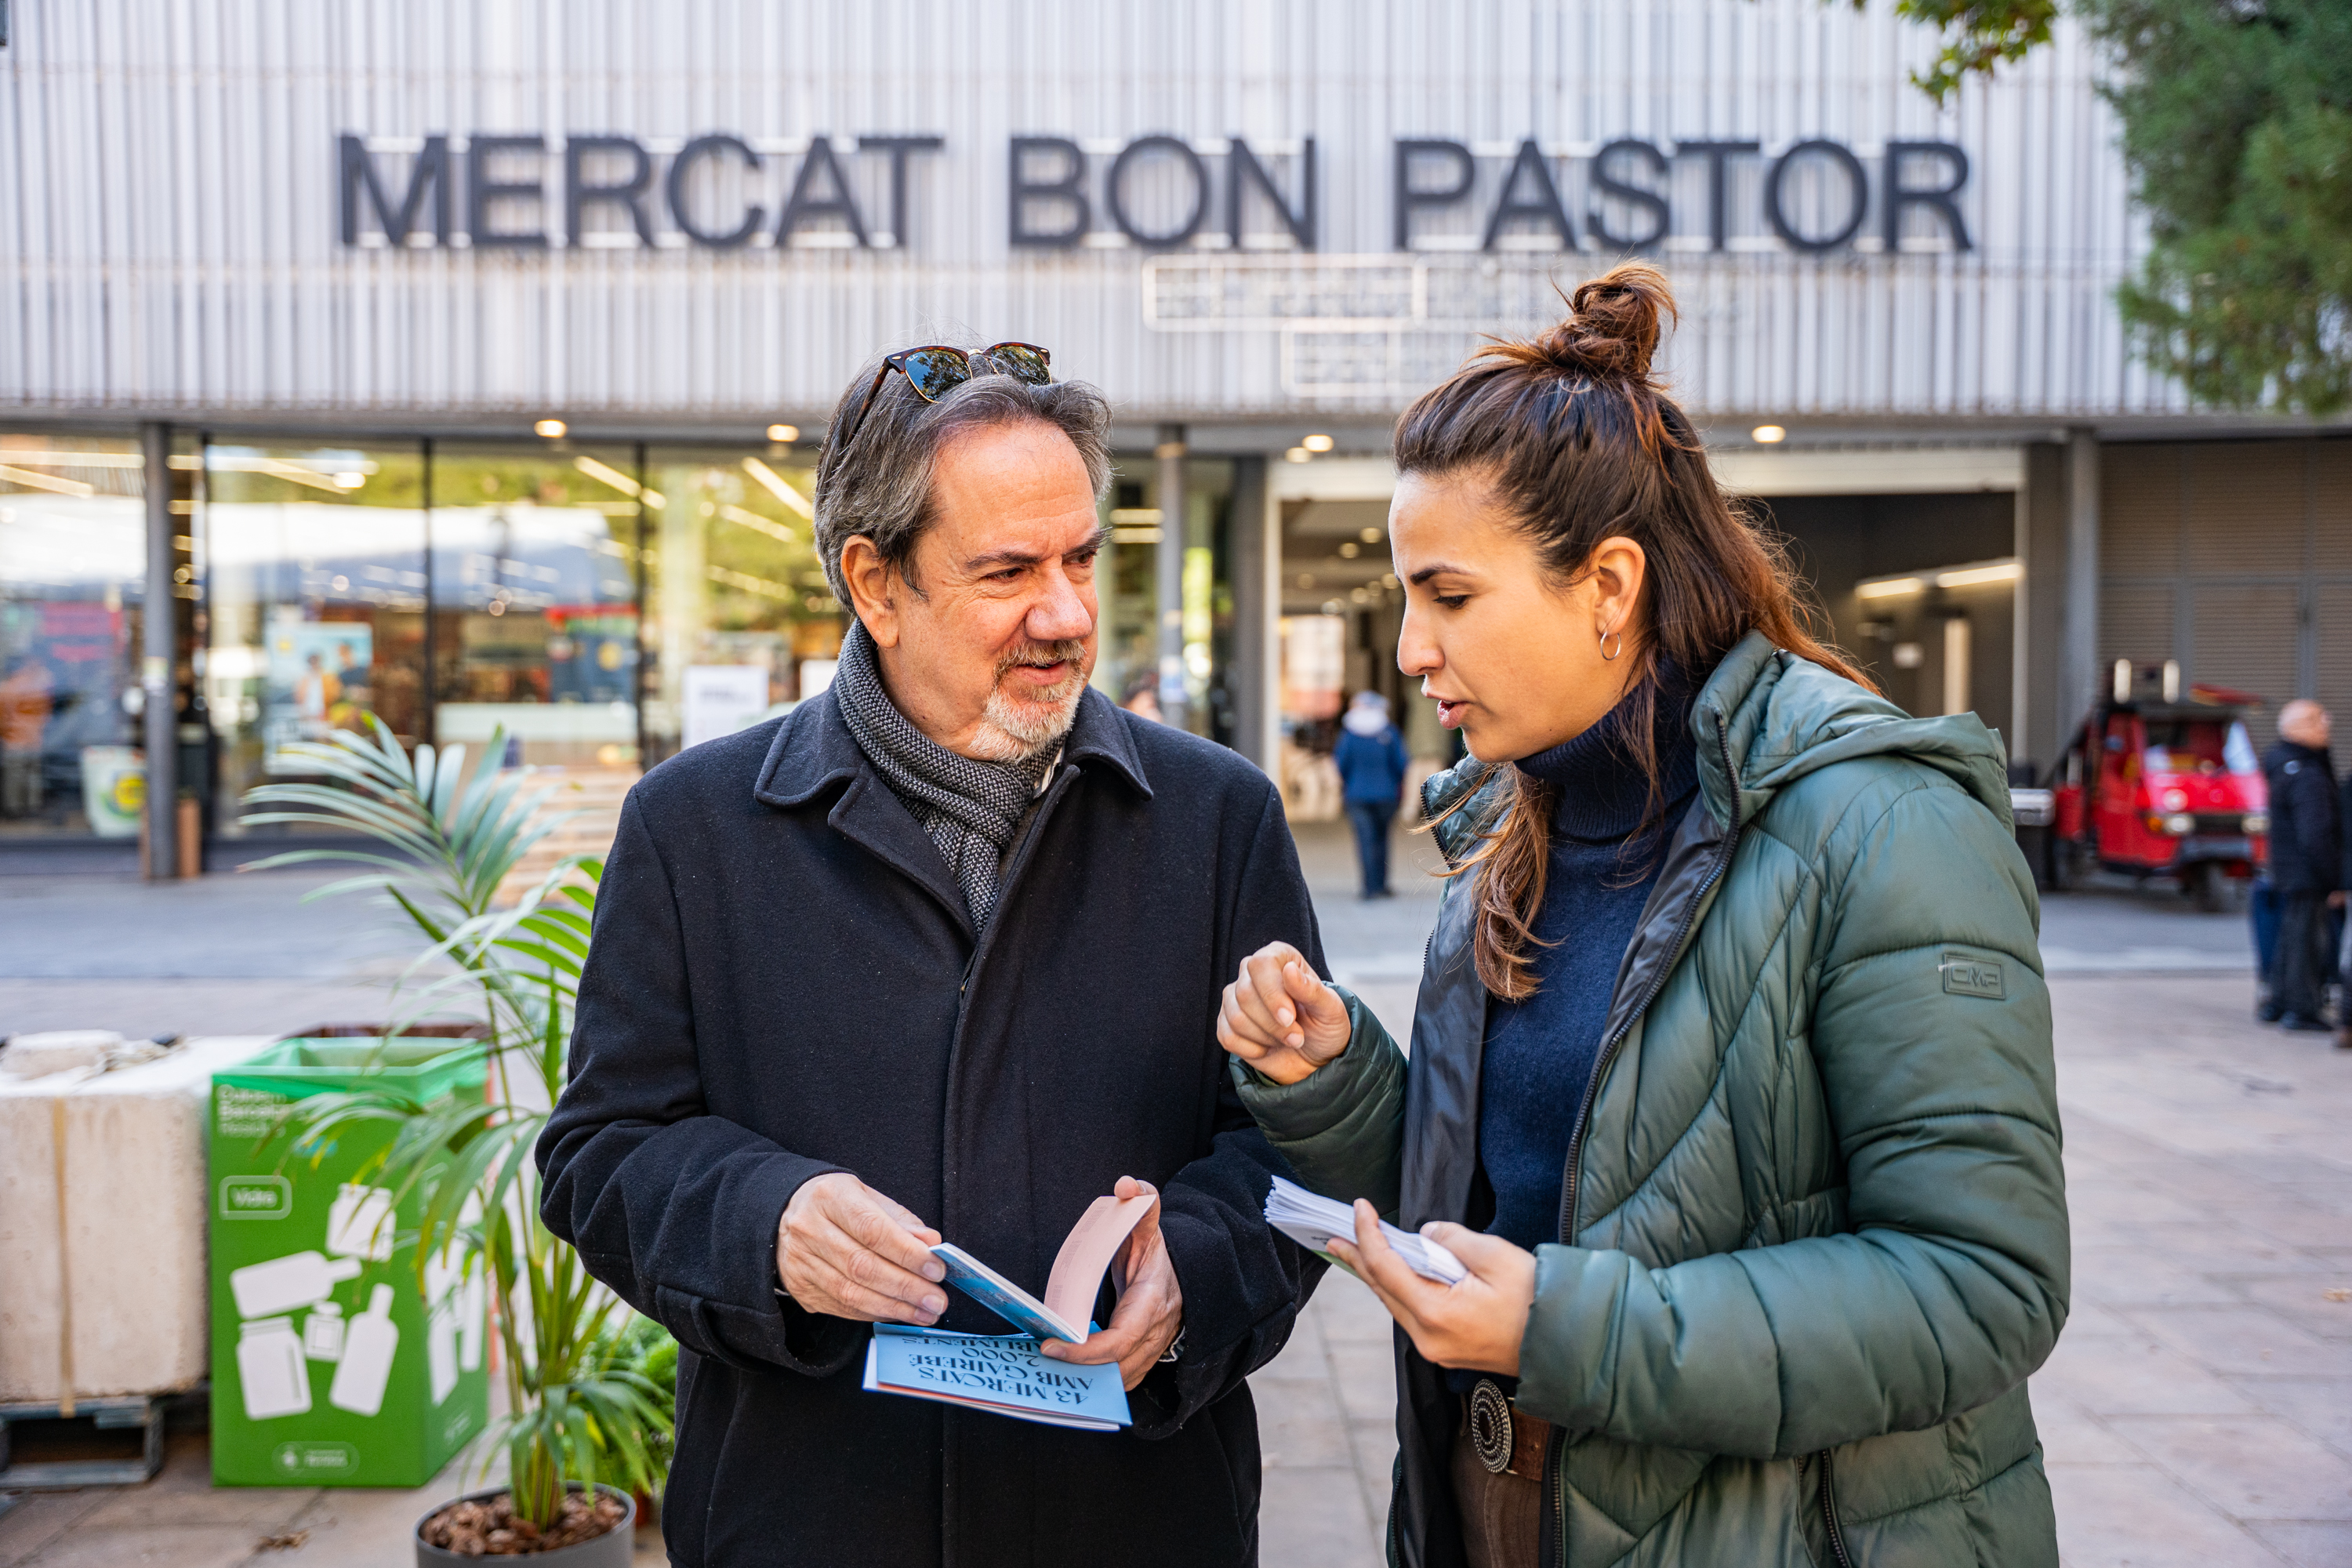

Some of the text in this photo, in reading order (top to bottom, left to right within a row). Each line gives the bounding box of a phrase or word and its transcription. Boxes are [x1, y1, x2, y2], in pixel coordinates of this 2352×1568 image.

[339, 135, 1974, 254] MERCAT BON PASTOR
[909, 1354, 1093, 1390] AMB GAIREBÉ
[961, 1348, 1040, 1367] 2.000
[919, 1367, 1089, 1405] 43 MERCATS
